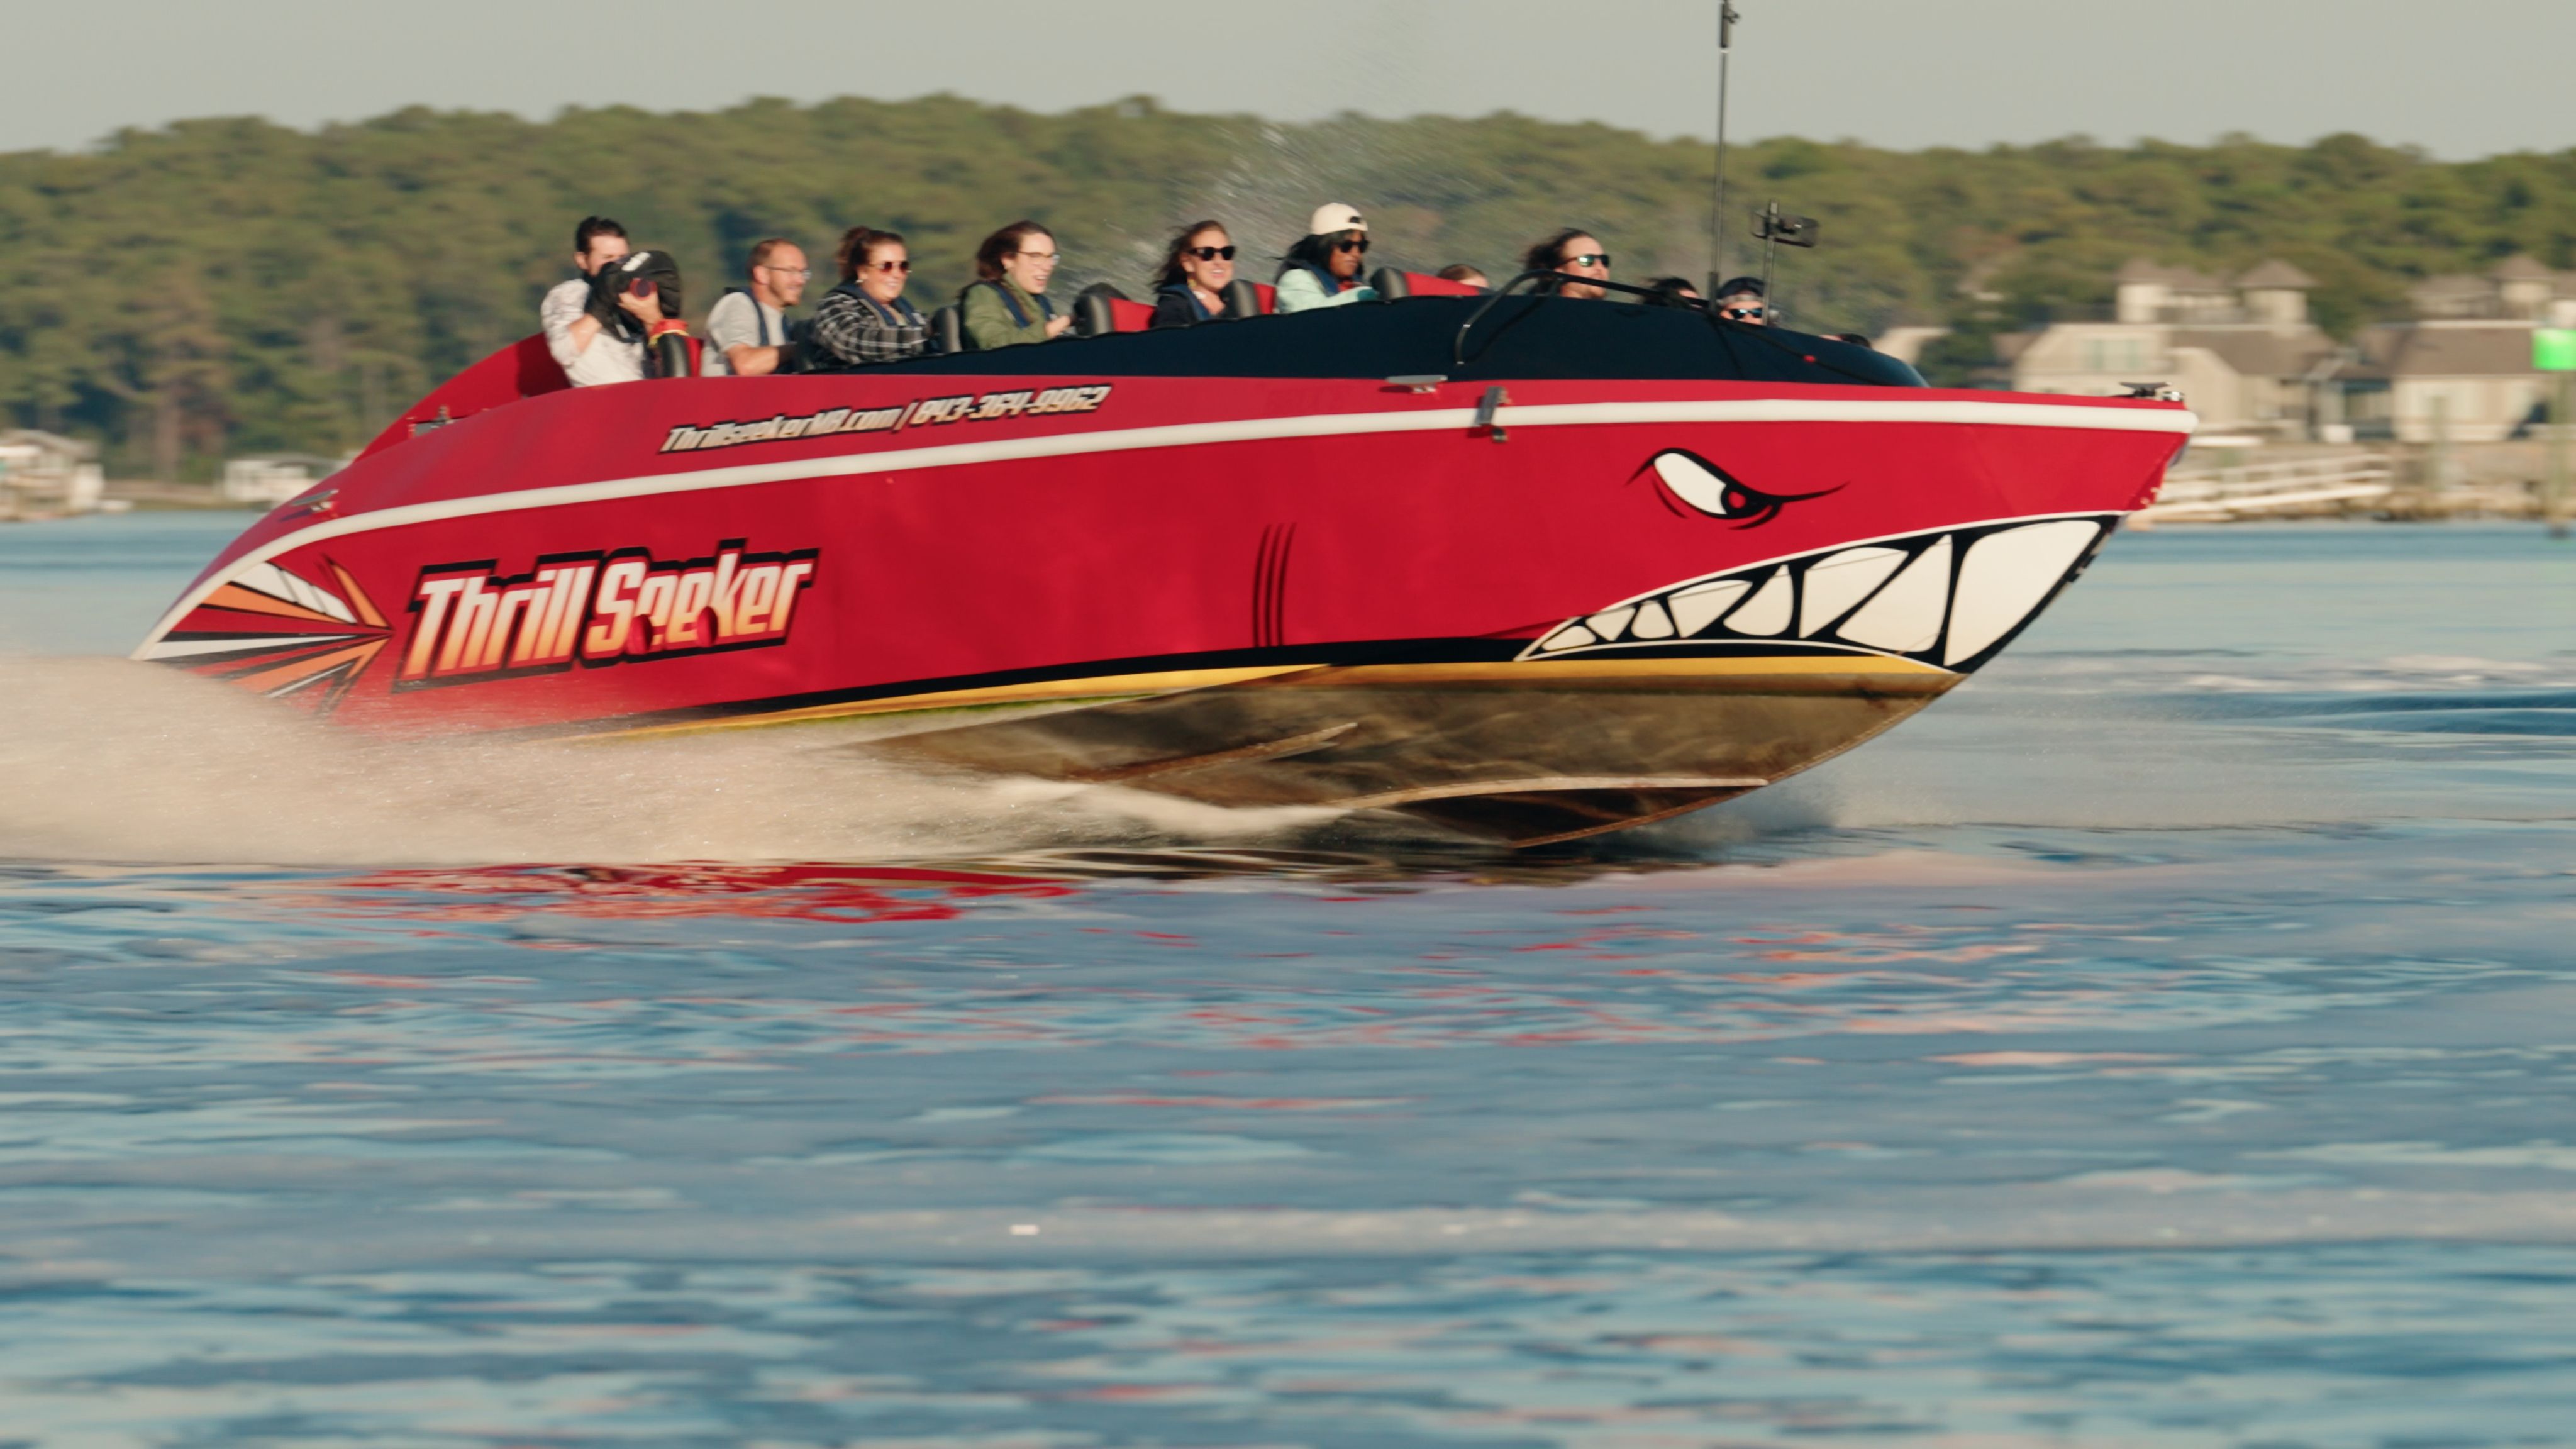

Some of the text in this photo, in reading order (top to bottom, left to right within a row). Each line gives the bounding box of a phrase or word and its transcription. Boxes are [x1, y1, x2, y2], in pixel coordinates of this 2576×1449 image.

[909, 386, 1112, 425] 843-364-9962
[403, 552, 813, 679] Thrill Seeker
